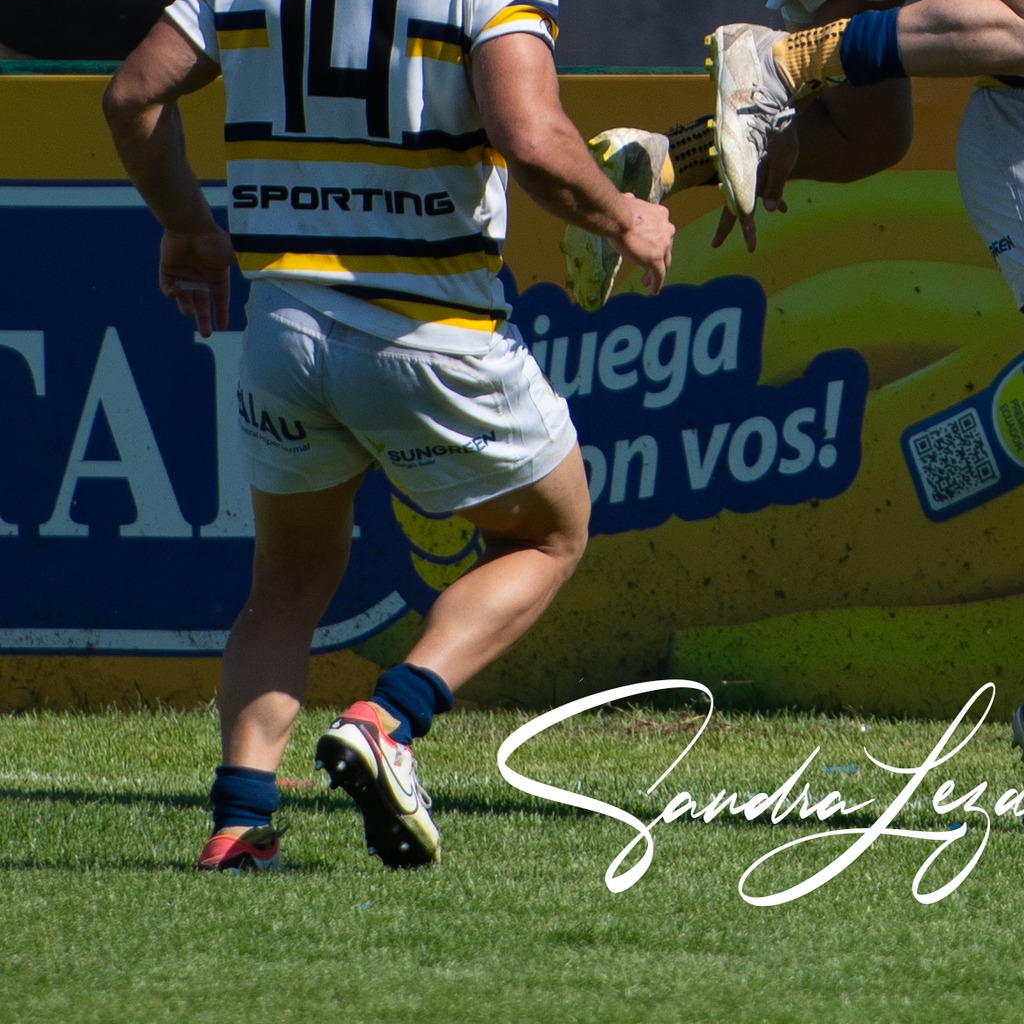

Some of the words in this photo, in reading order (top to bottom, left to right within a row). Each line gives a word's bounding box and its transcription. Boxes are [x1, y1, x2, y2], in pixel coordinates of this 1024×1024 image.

[232, 185, 456, 216] SPORTING
[387, 430, 497, 464] SUNGREEN
[681, 380, 845, 491] vos!
